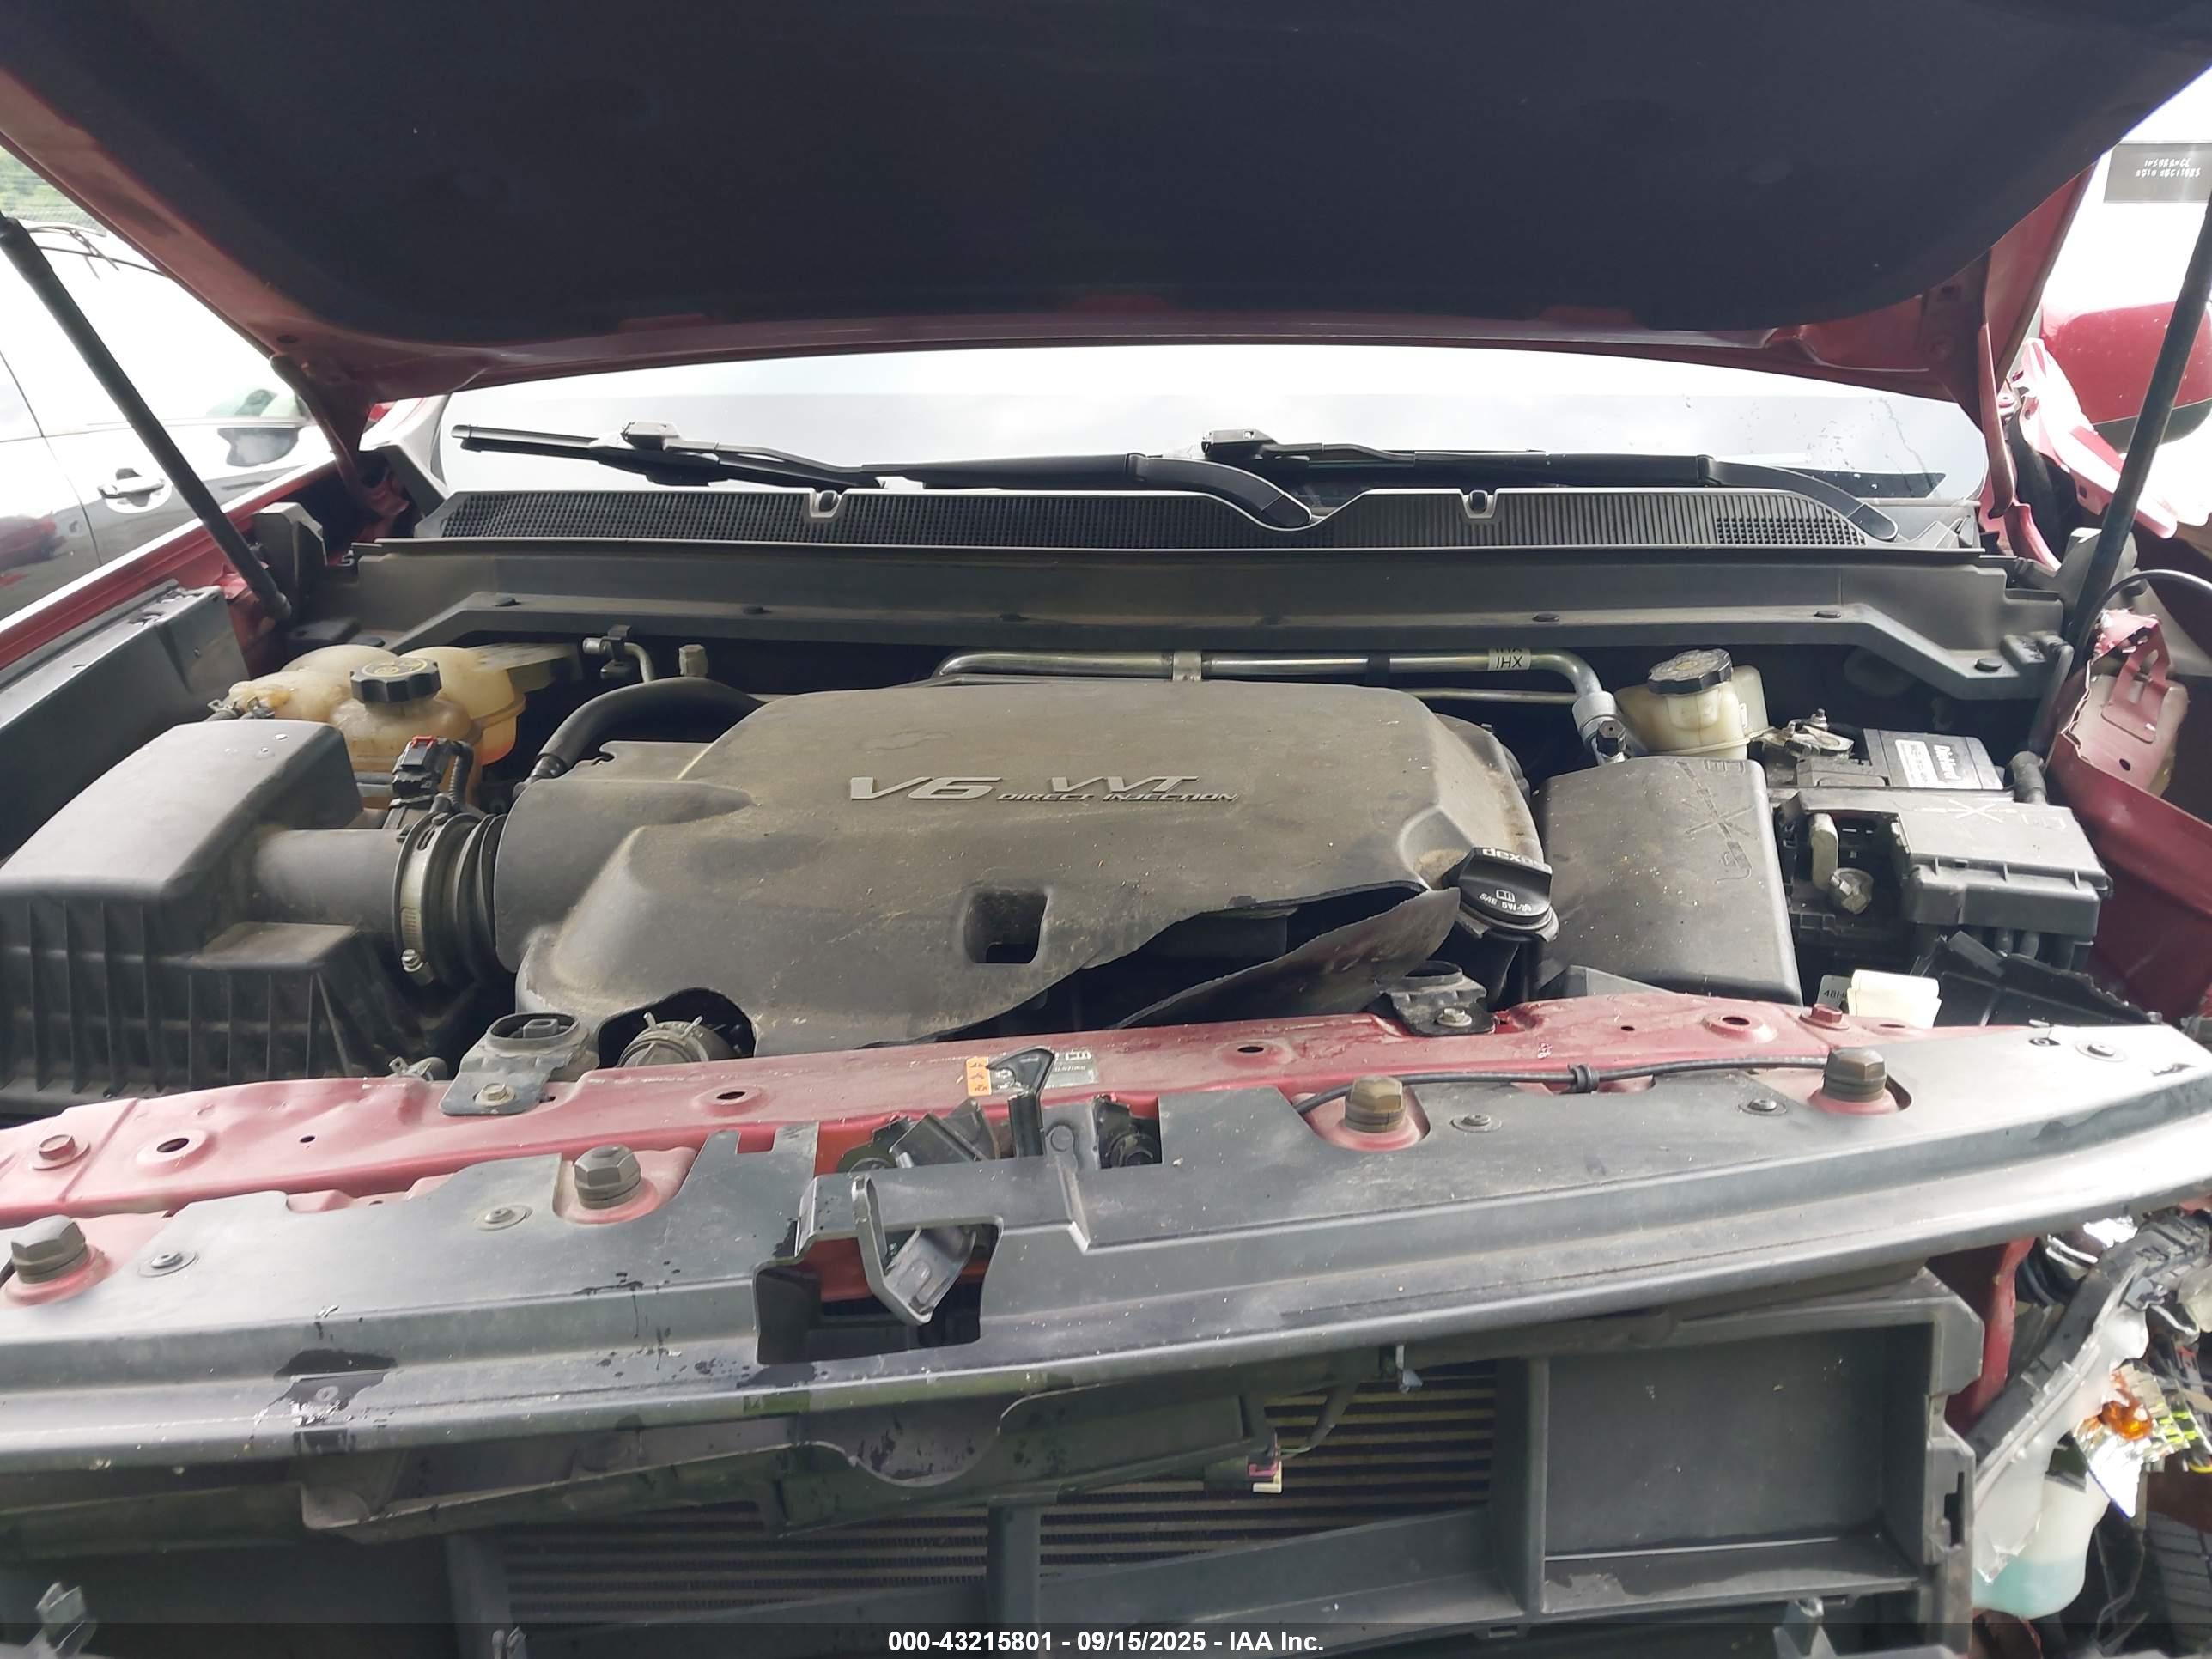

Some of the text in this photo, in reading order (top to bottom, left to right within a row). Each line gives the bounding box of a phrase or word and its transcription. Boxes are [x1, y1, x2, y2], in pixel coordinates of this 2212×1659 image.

[850, 776, 1200, 800] V6 VVT
[996, 792, 1238, 802] DIRECT INJECTION
